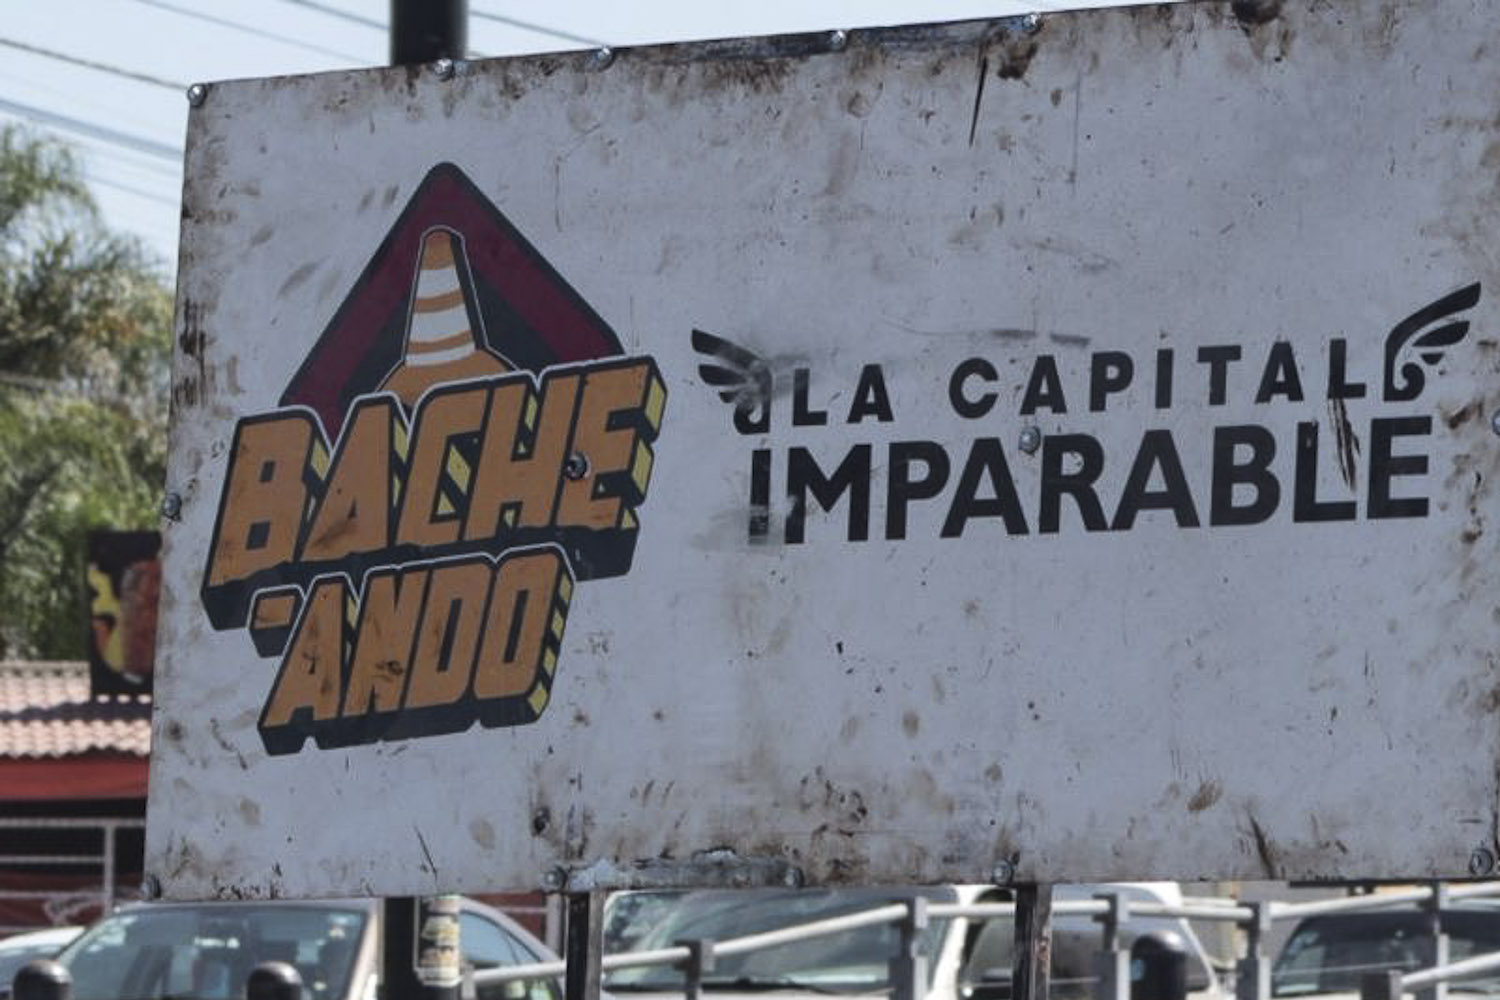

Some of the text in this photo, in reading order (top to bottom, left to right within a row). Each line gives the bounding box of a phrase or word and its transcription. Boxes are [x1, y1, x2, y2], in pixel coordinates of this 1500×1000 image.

[792, 338, 1366, 427] LA CAPITAL
[203, 358, 667, 620] BACHE
[748, 416, 1433, 546] IMPARABLE
